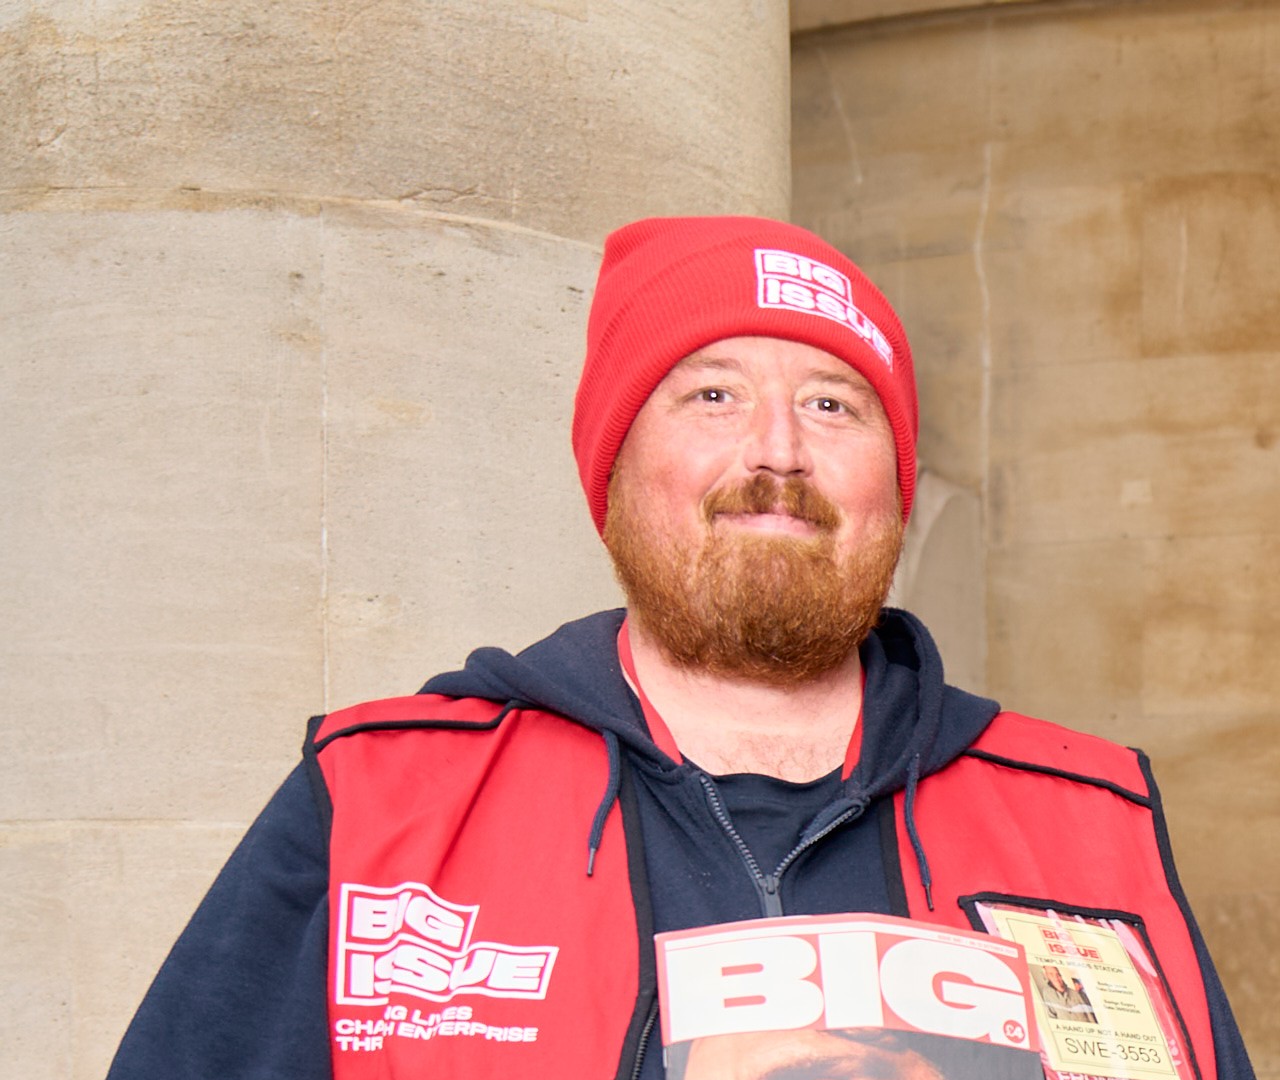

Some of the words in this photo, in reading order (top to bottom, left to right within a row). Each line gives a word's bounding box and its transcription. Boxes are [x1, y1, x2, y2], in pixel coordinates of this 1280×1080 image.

[763, 254, 846, 297] BIG
[766, 280, 891, 353] ISSUE
[351, 892, 465, 948] BIG
[667, 931, 1029, 1048] BIG
[1004, 1023, 1024, 1040] £4
[1063, 1024, 1083, 1033] HAND
[1121, 1031, 1141, 1041] HAND
[1143, 1034, 1157, 1042] OUT
[1065, 1037, 1161, 1064] SWE-3553
